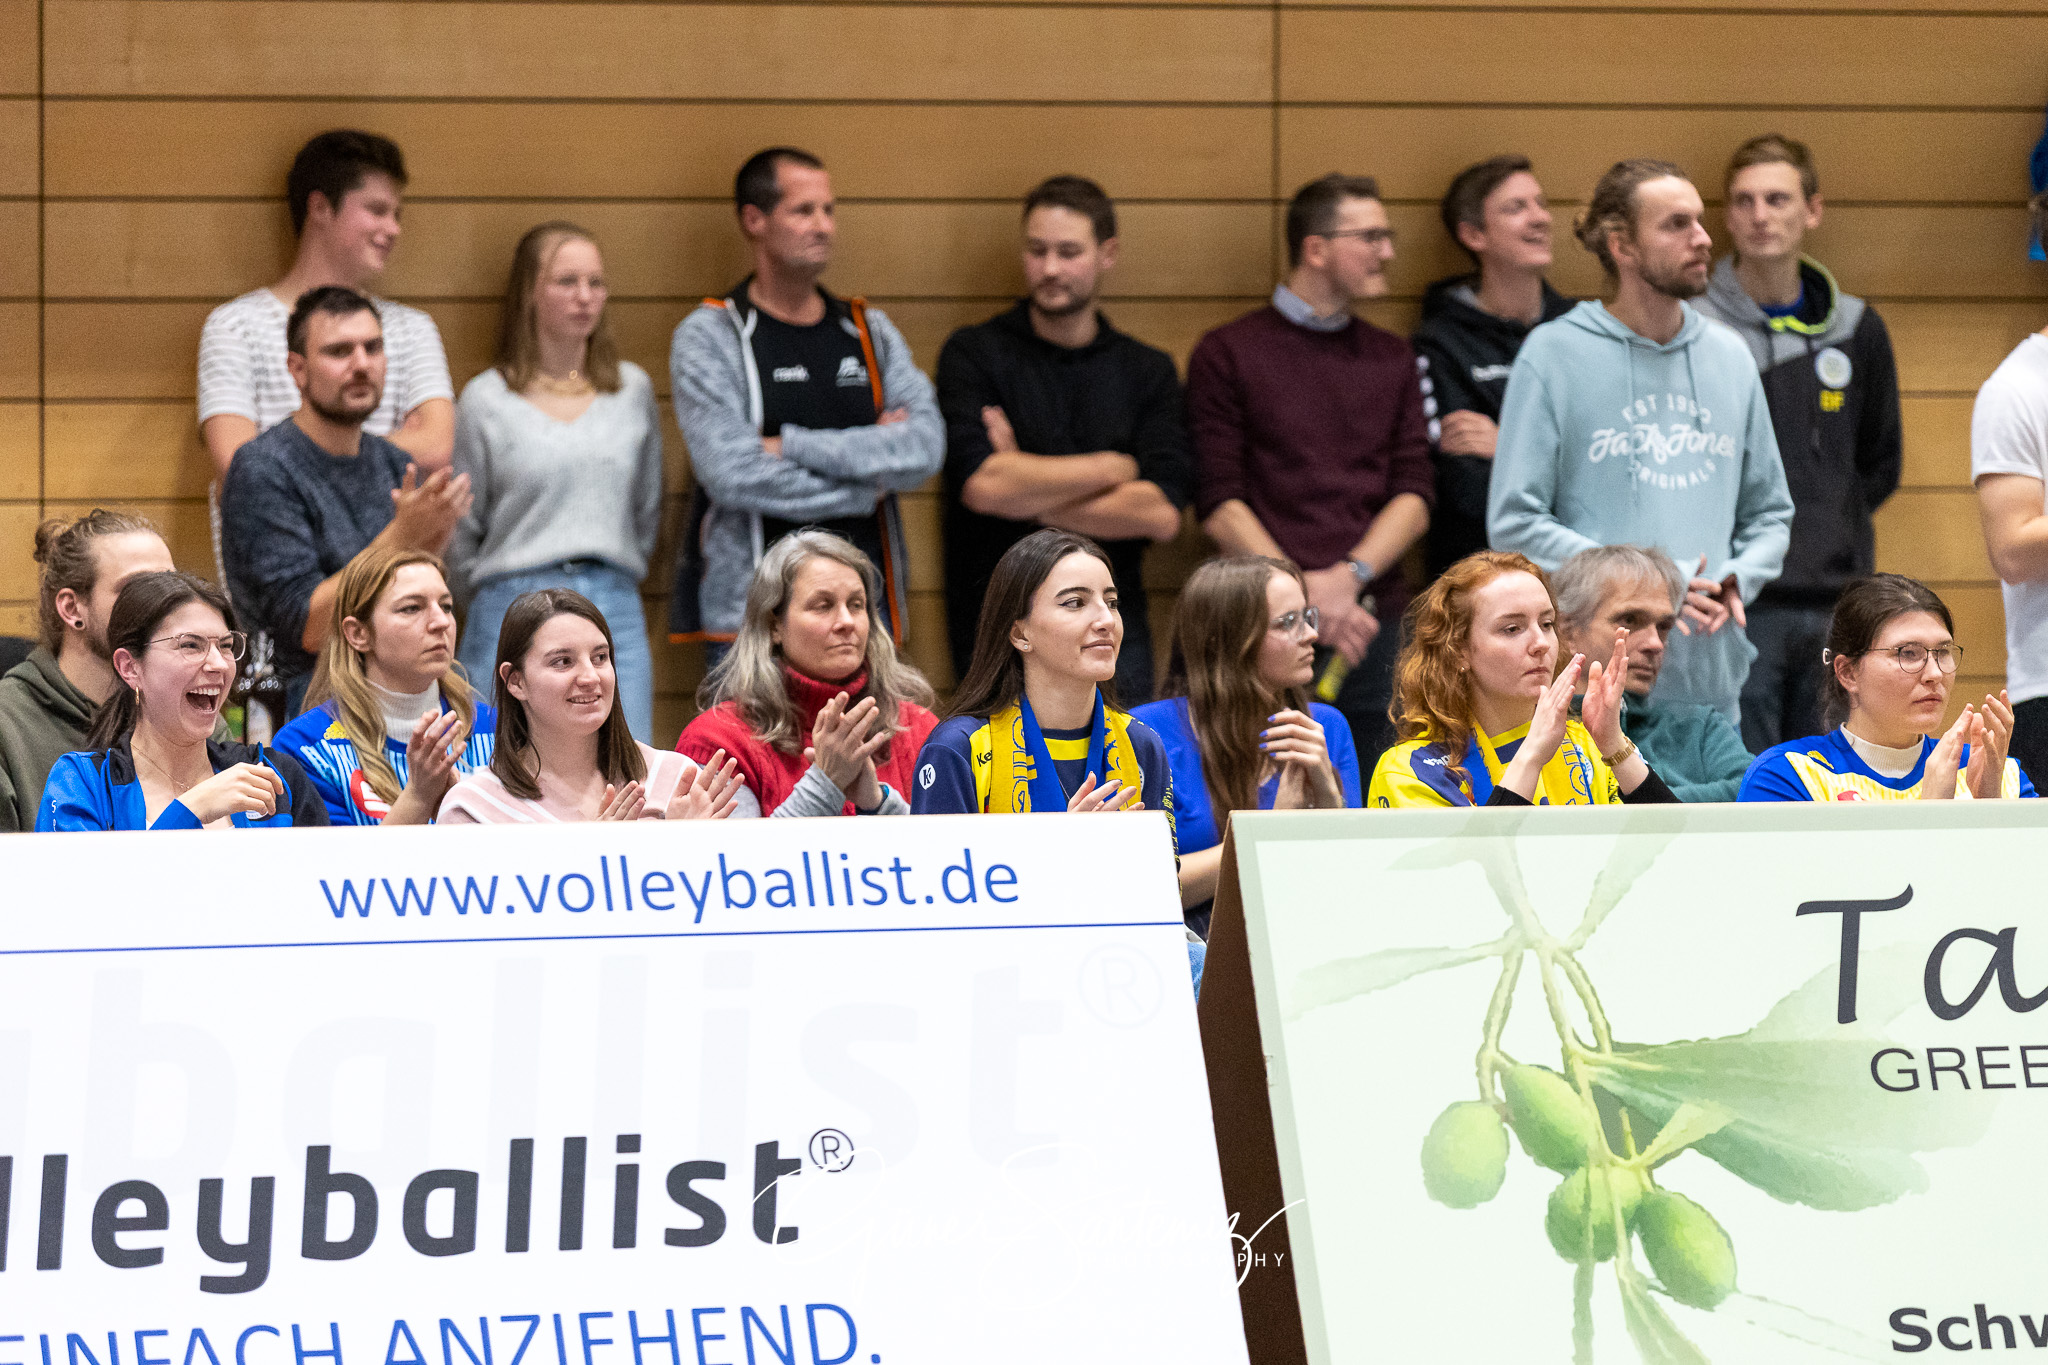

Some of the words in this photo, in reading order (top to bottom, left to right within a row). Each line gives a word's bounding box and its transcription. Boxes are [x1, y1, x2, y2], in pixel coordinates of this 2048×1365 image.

[319, 849, 1019, 924] www.volleyballist.de
[1796, 883, 2048, 1025] Ta
[1870, 1045, 2048, 1092] GREE
[384, 1303, 881, 1365] ANZIEHEND.
